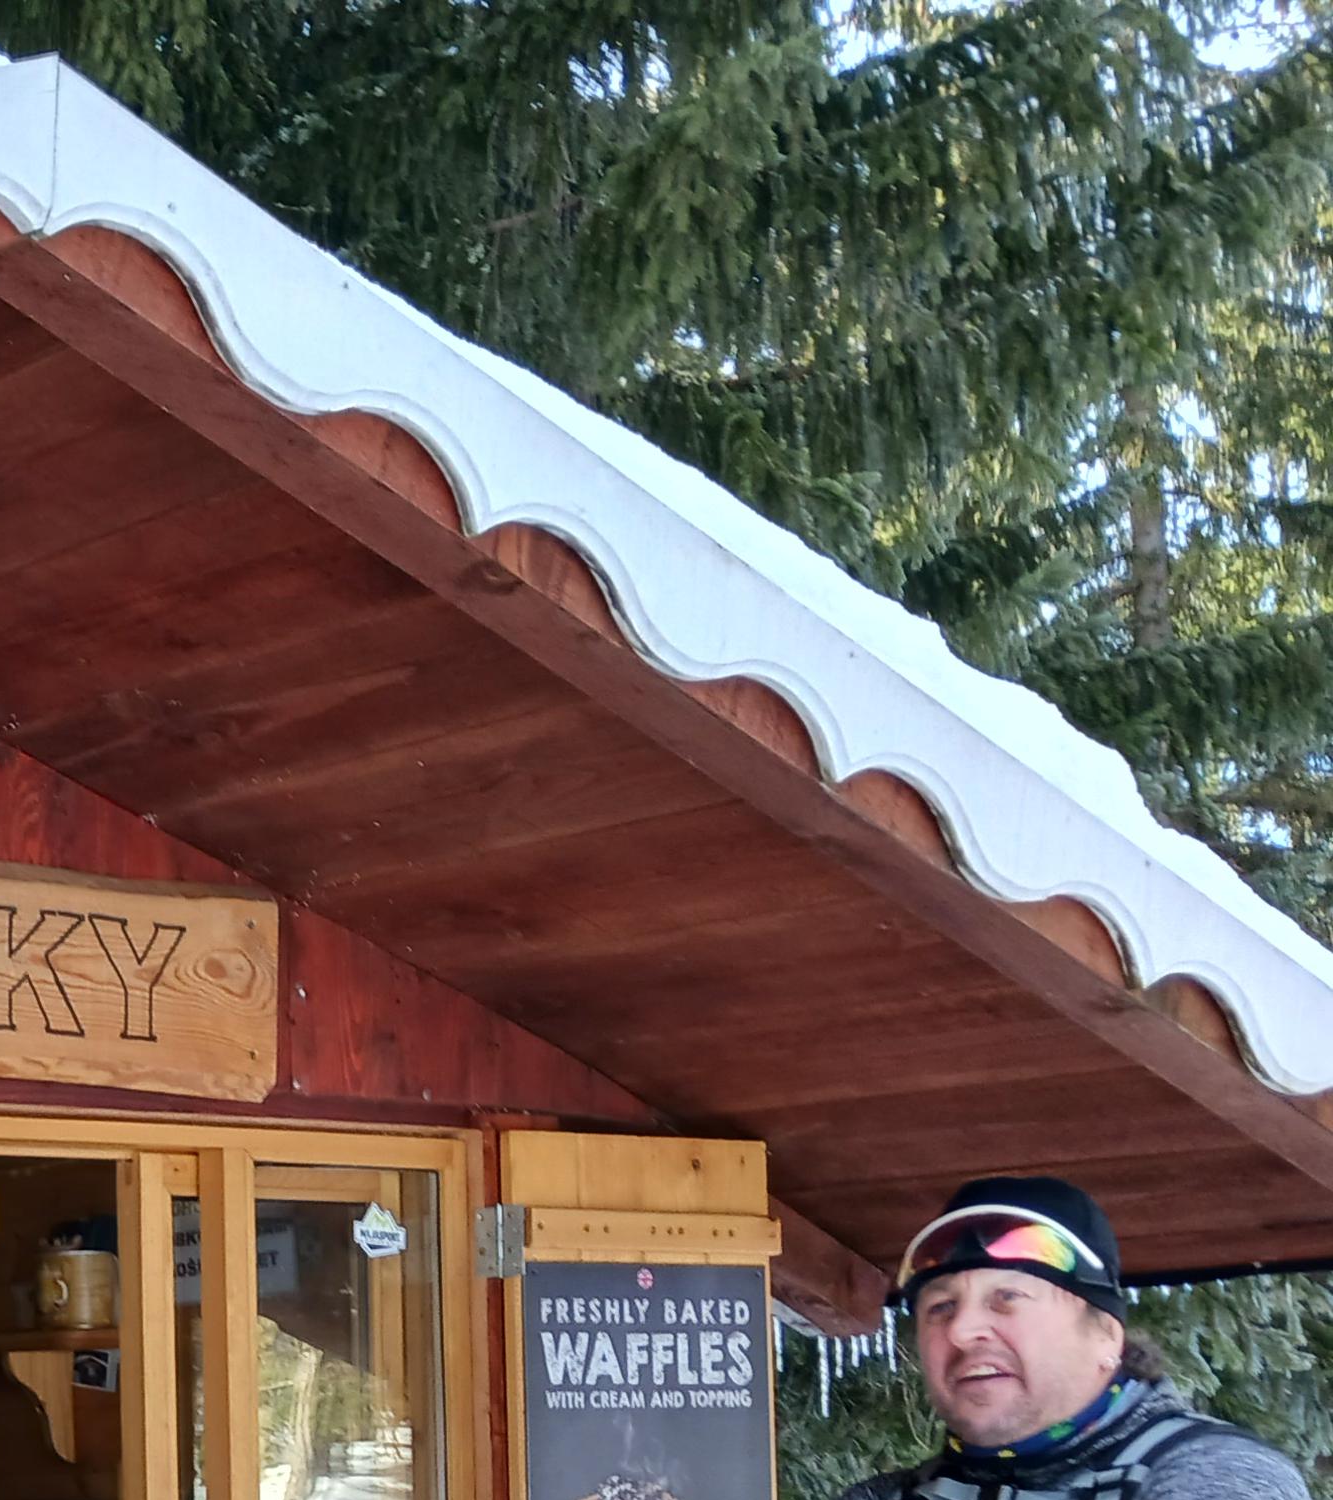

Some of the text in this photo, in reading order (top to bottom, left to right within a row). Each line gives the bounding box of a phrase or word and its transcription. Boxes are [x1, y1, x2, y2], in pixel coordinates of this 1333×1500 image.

[540, 1297, 751, 1326] FRESHLY BAKED
[540, 1330, 754, 1387] WAFFLES
[545, 1389, 753, 1409] WITH CREAM AND TOPPING
